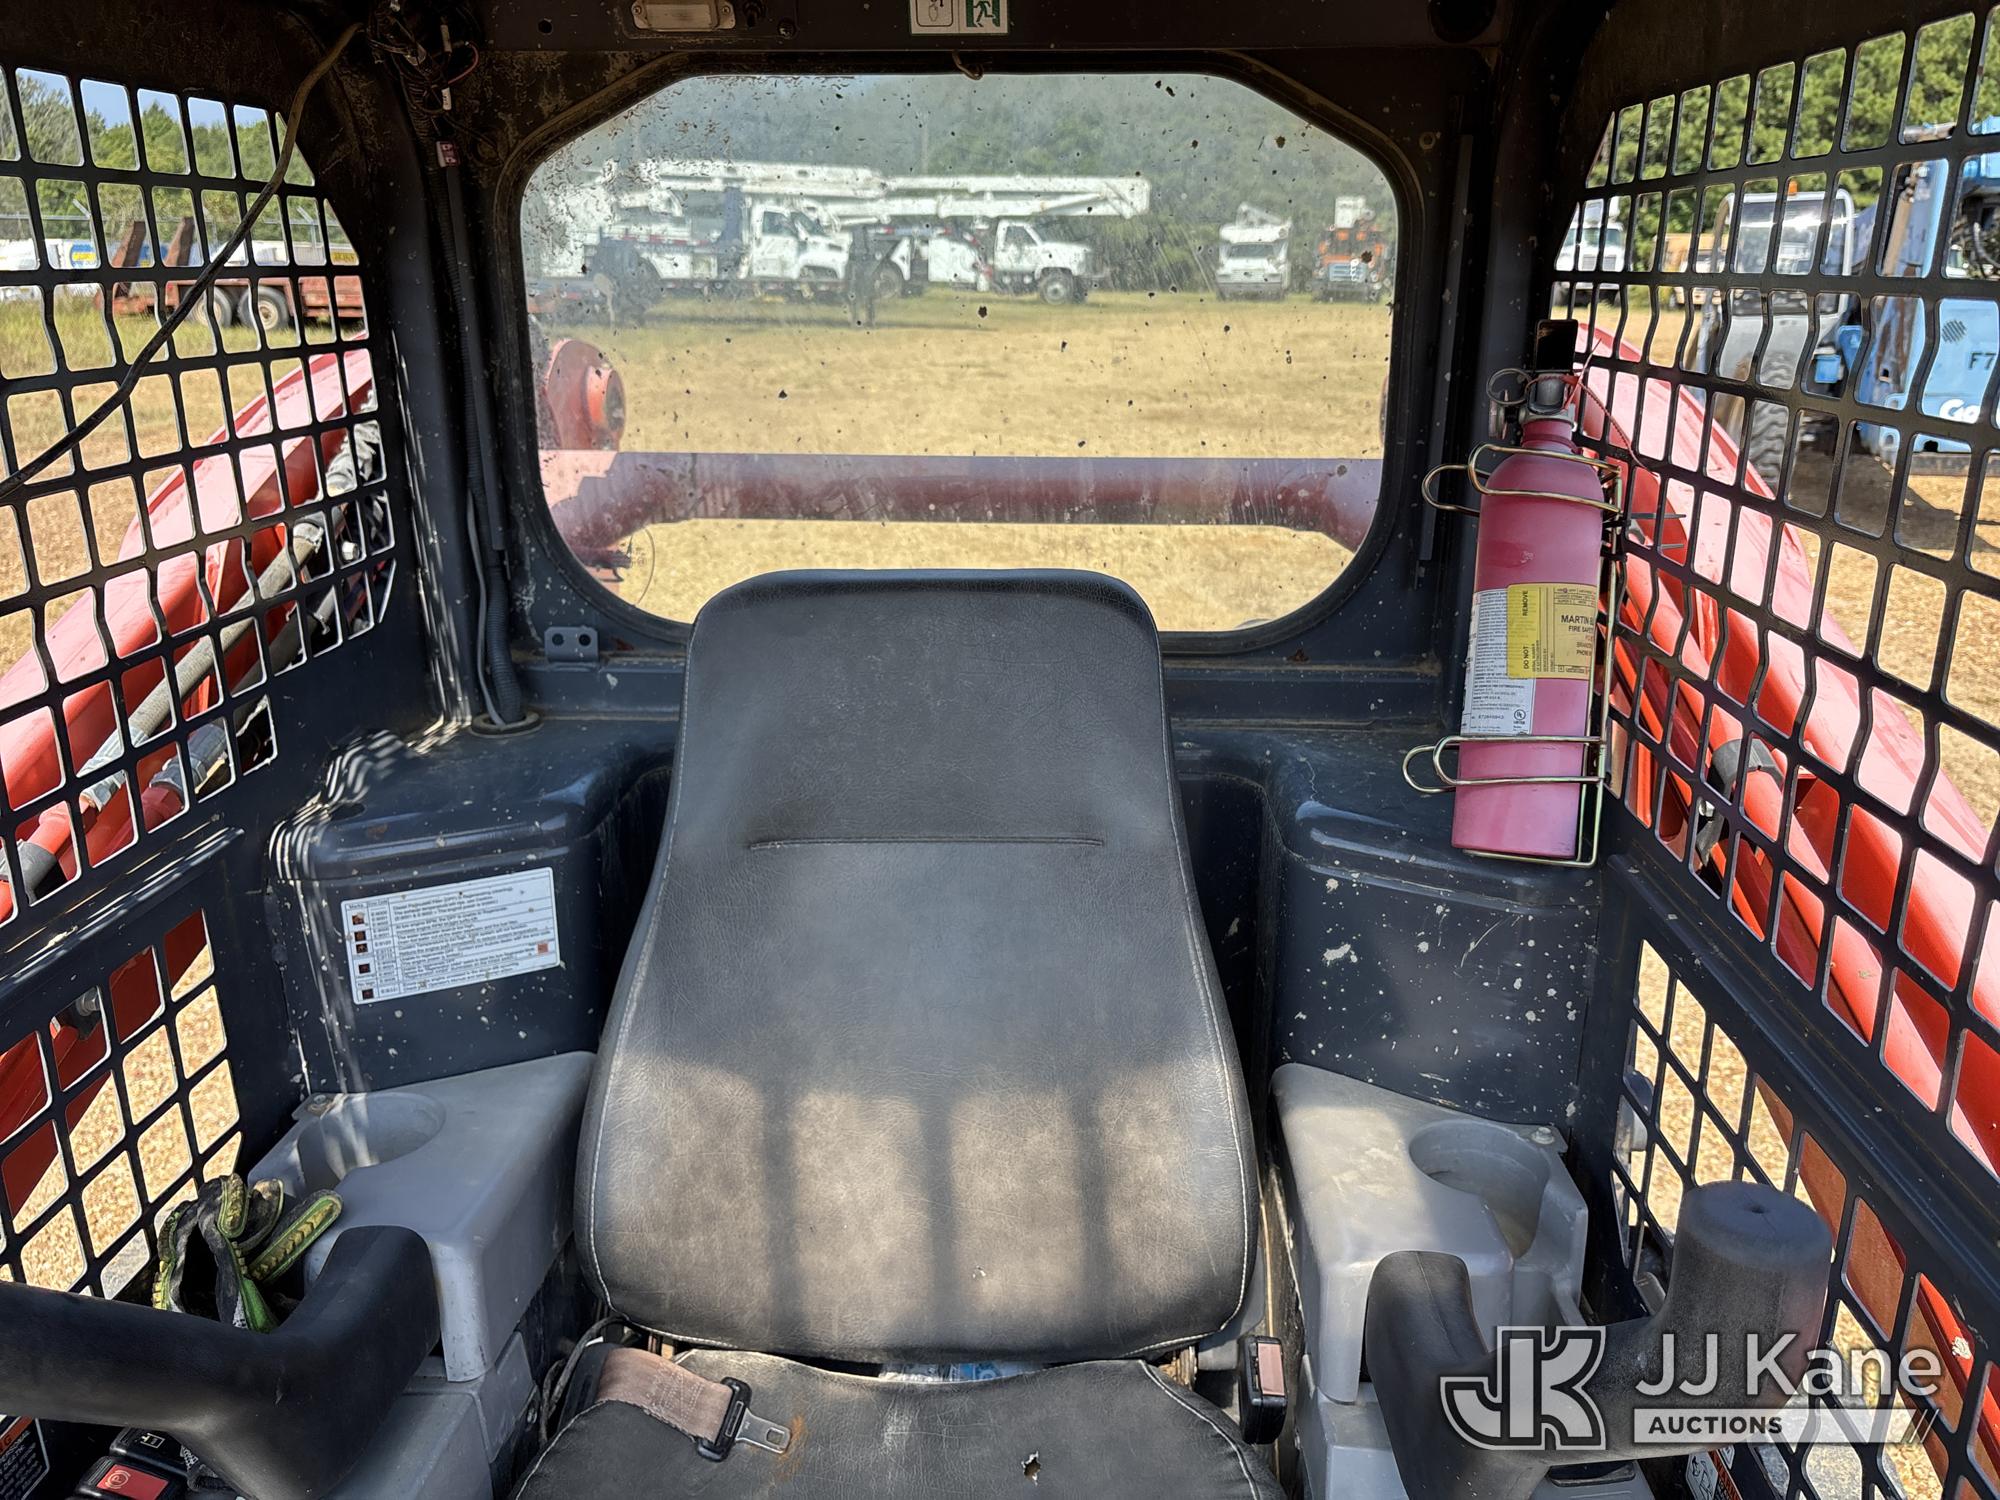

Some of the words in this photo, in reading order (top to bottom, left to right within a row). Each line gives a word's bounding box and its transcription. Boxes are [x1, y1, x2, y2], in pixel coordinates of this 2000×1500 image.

[1561, 614, 1589, 625] MARTIN
[1522, 646, 1530, 659] NOT
[1523, 659, 1530, 670] DO
